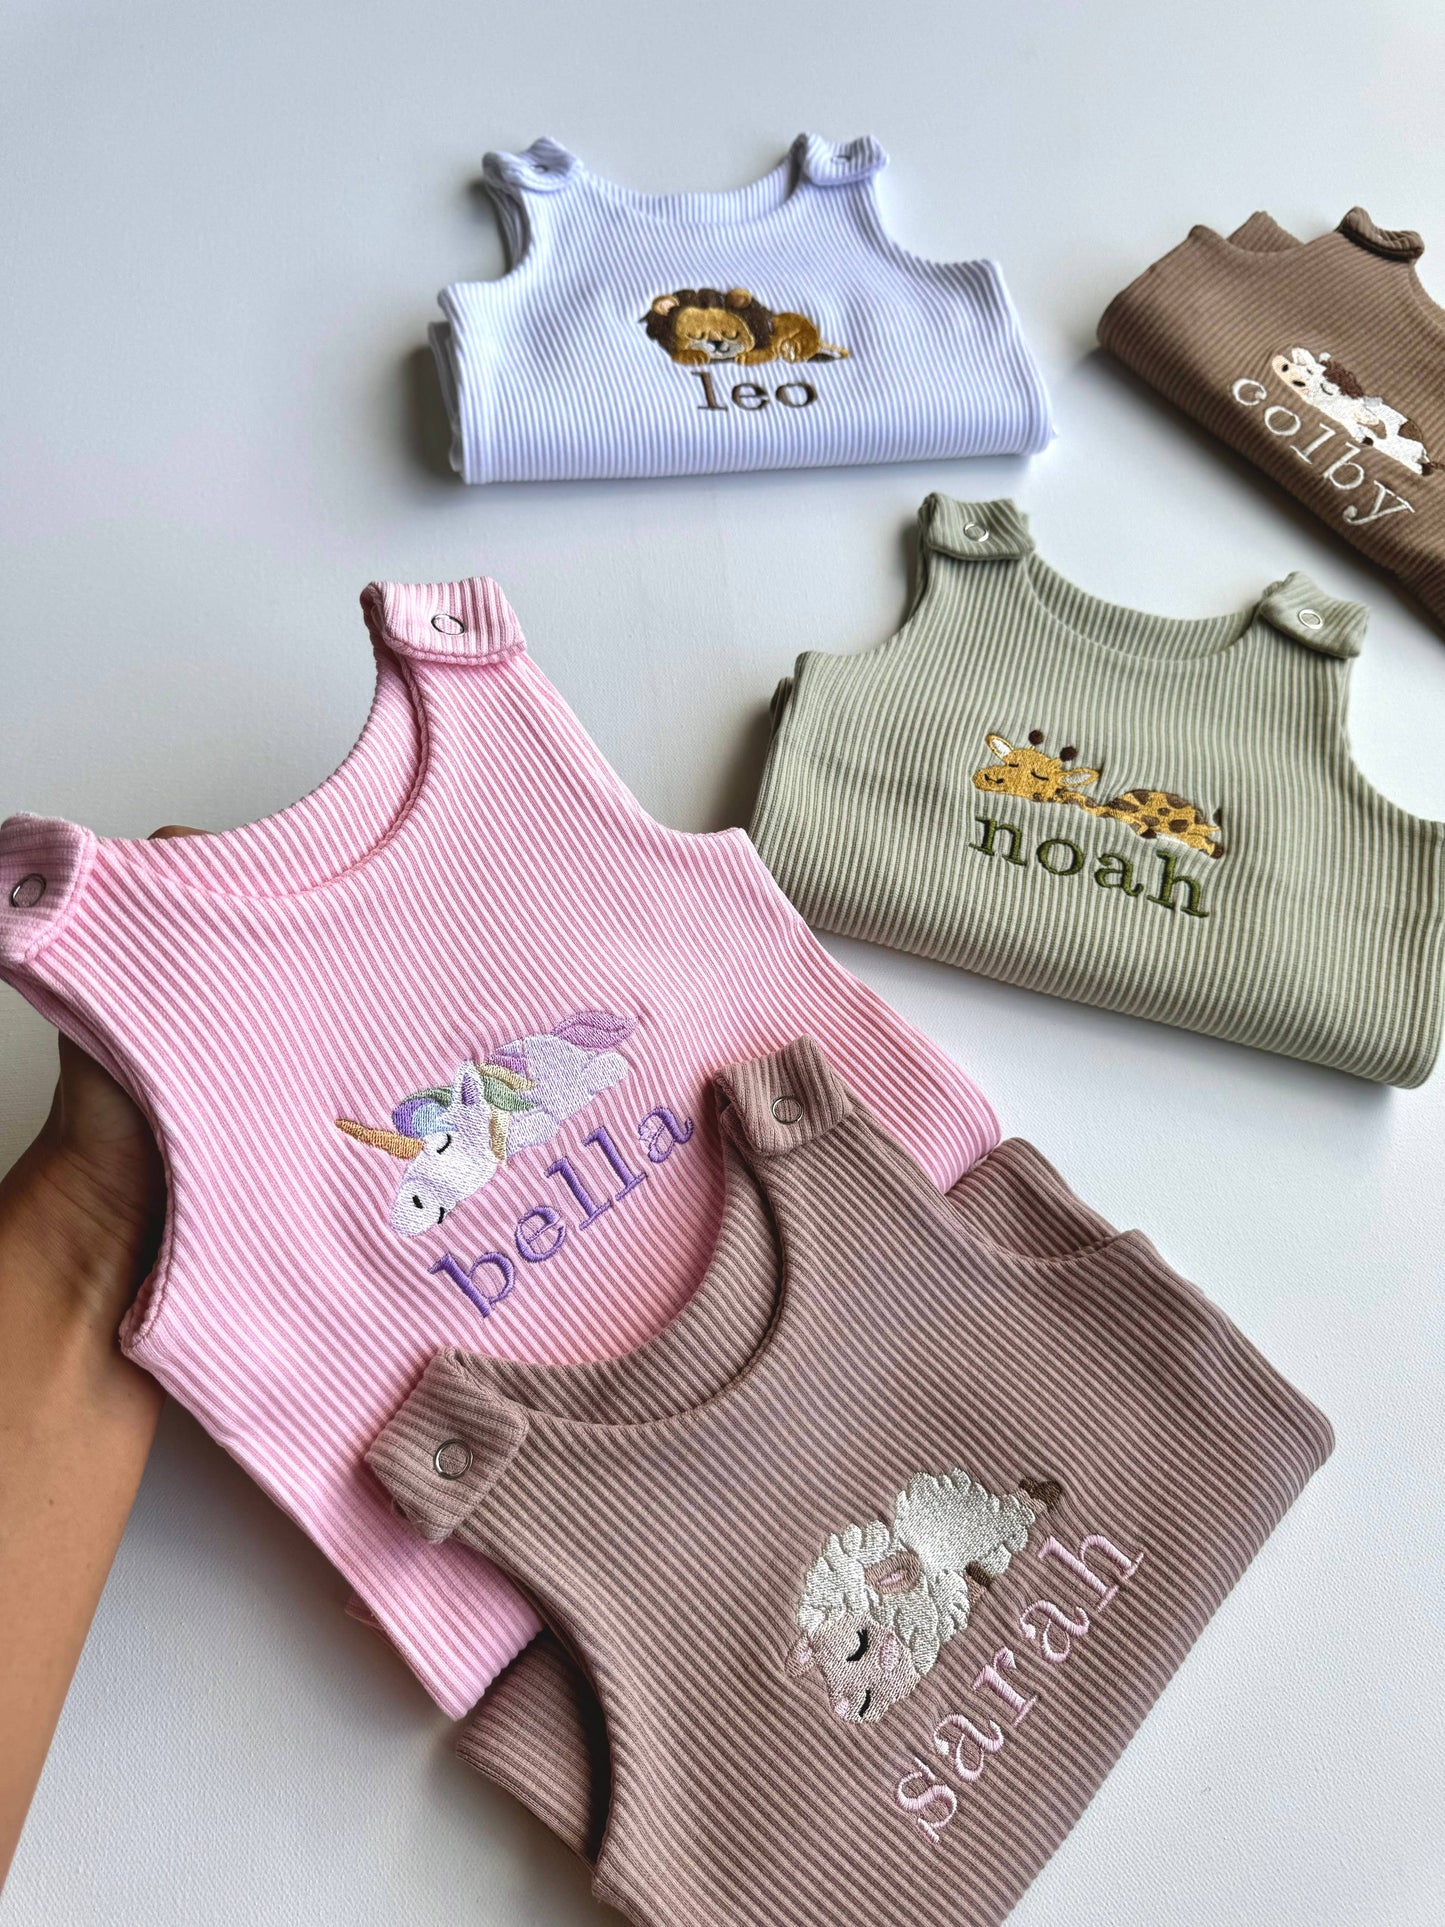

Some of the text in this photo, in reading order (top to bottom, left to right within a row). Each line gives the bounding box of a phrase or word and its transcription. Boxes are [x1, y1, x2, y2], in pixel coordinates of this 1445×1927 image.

[691, 371, 819, 412] leo
[1232, 378, 1416, 525] colby
[968, 816, 1209, 918] noah
[428, 1107, 694, 1318] bella
[897, 1534, 1144, 1843] sarah
